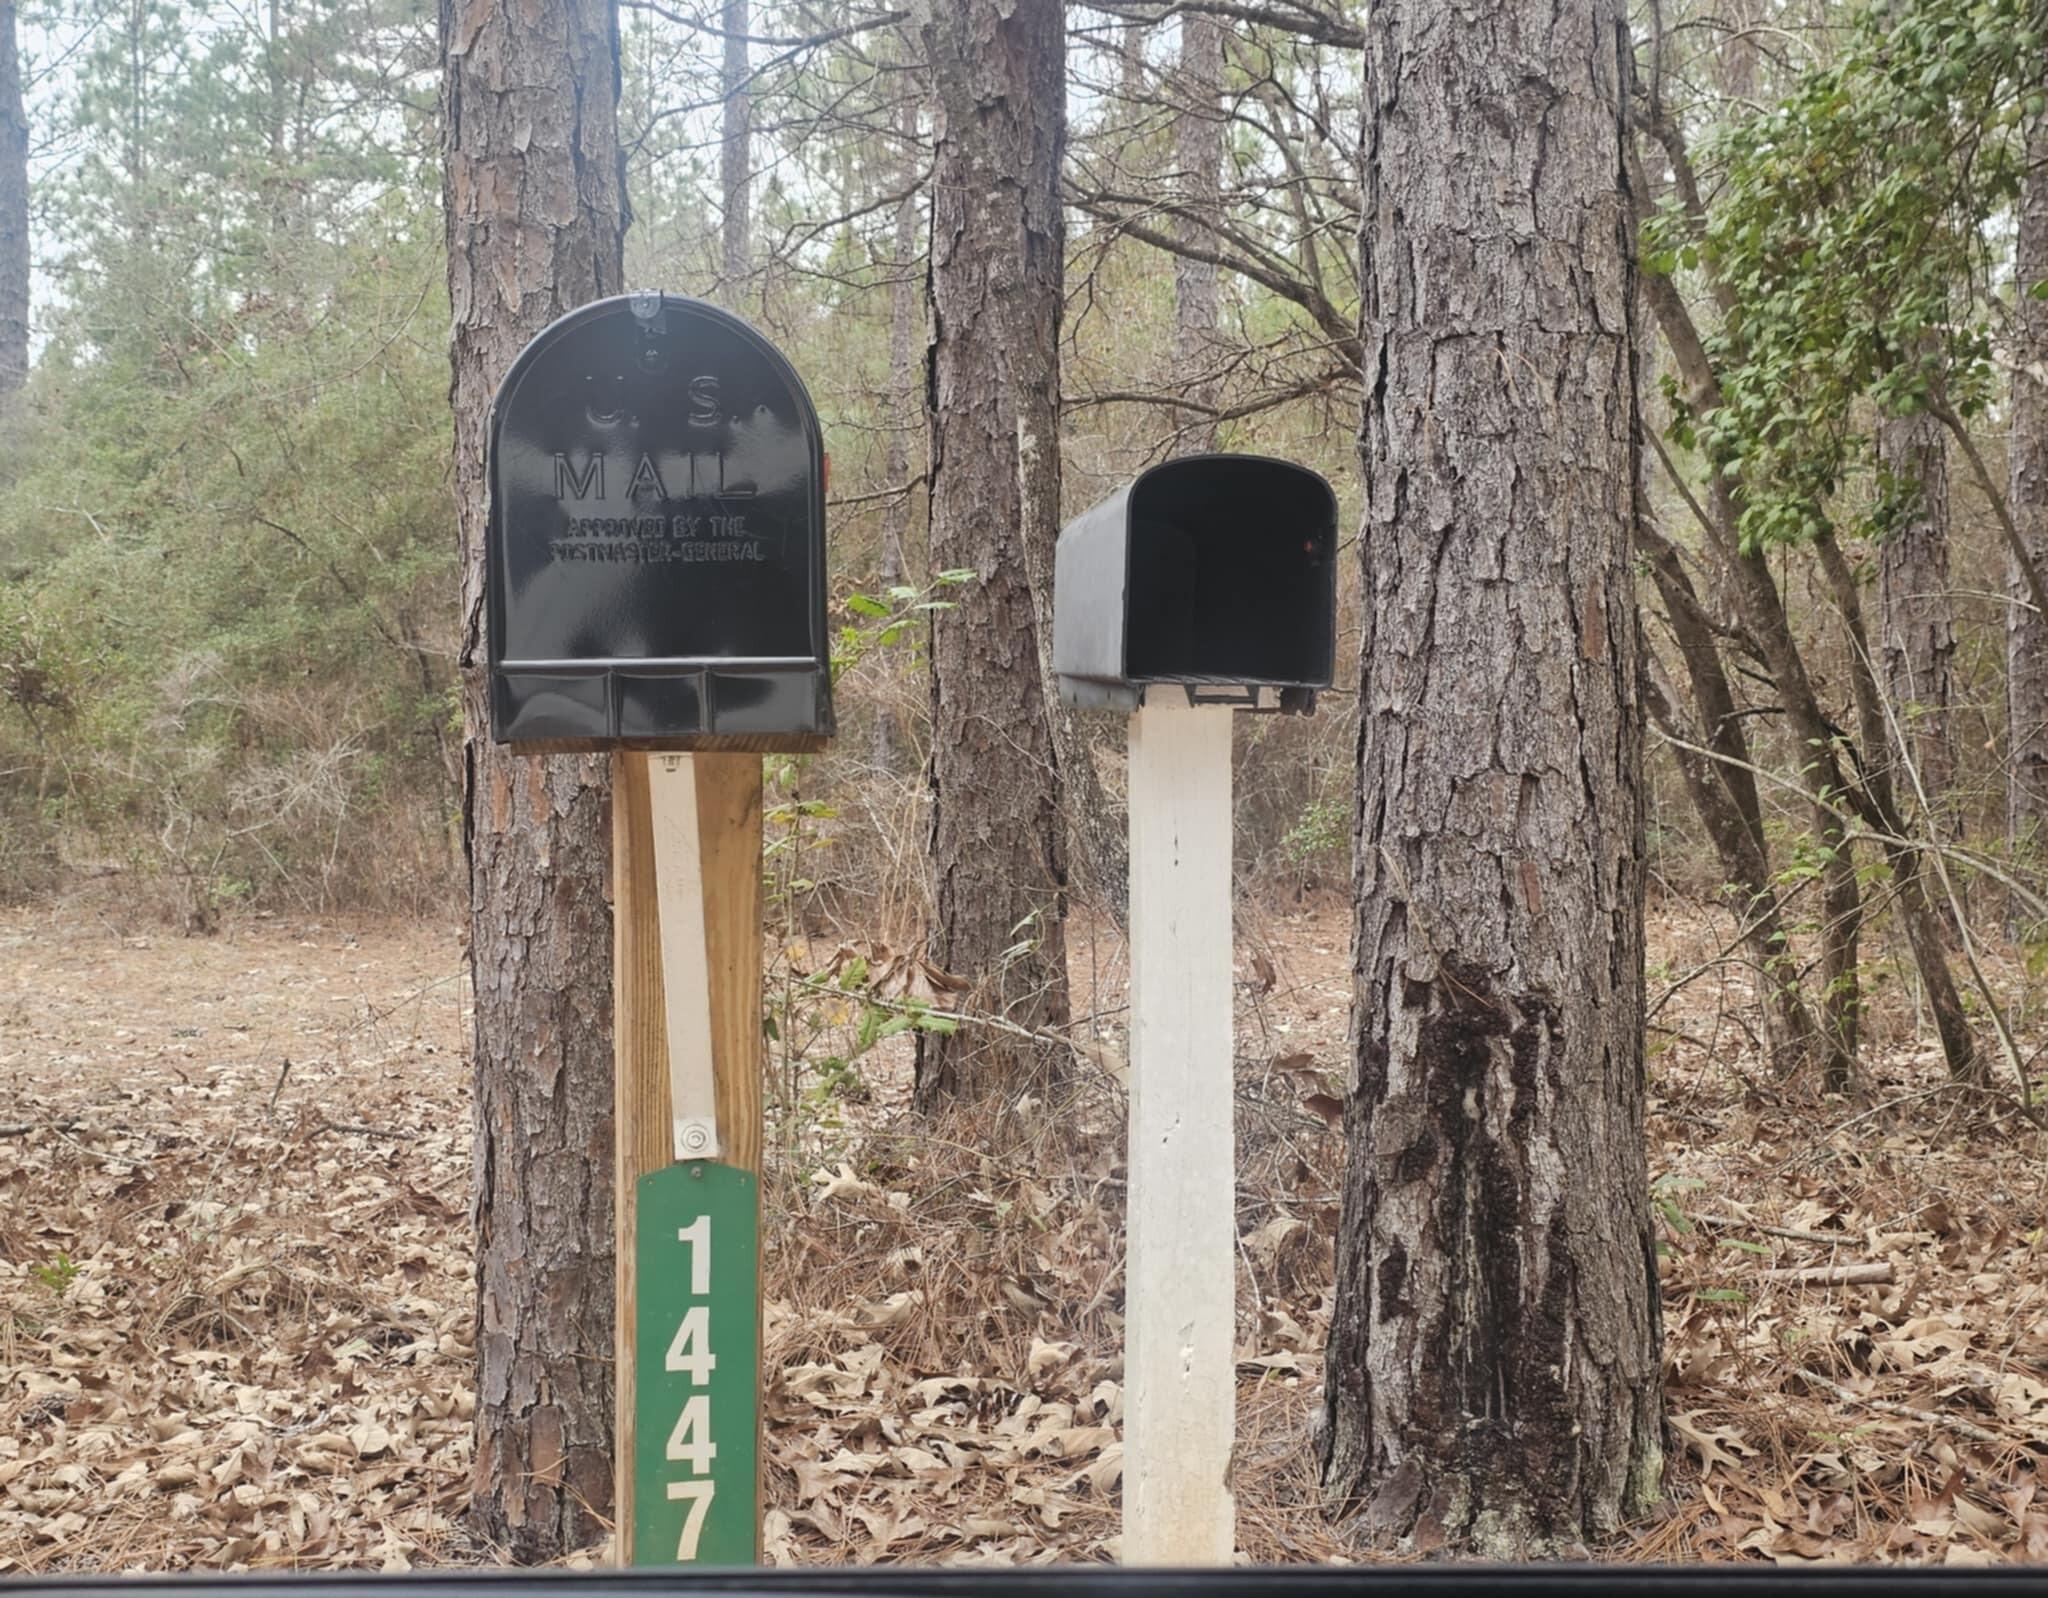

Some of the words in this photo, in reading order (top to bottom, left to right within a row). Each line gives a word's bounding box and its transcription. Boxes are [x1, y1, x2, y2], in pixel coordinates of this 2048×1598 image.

[554, 451, 756, 501] MAIL
[567, 515, 666, 539] APPROVED
[671, 515, 701, 538] BY
[709, 515, 748, 538] THE
[664, 1214, 717, 1561] 1447
